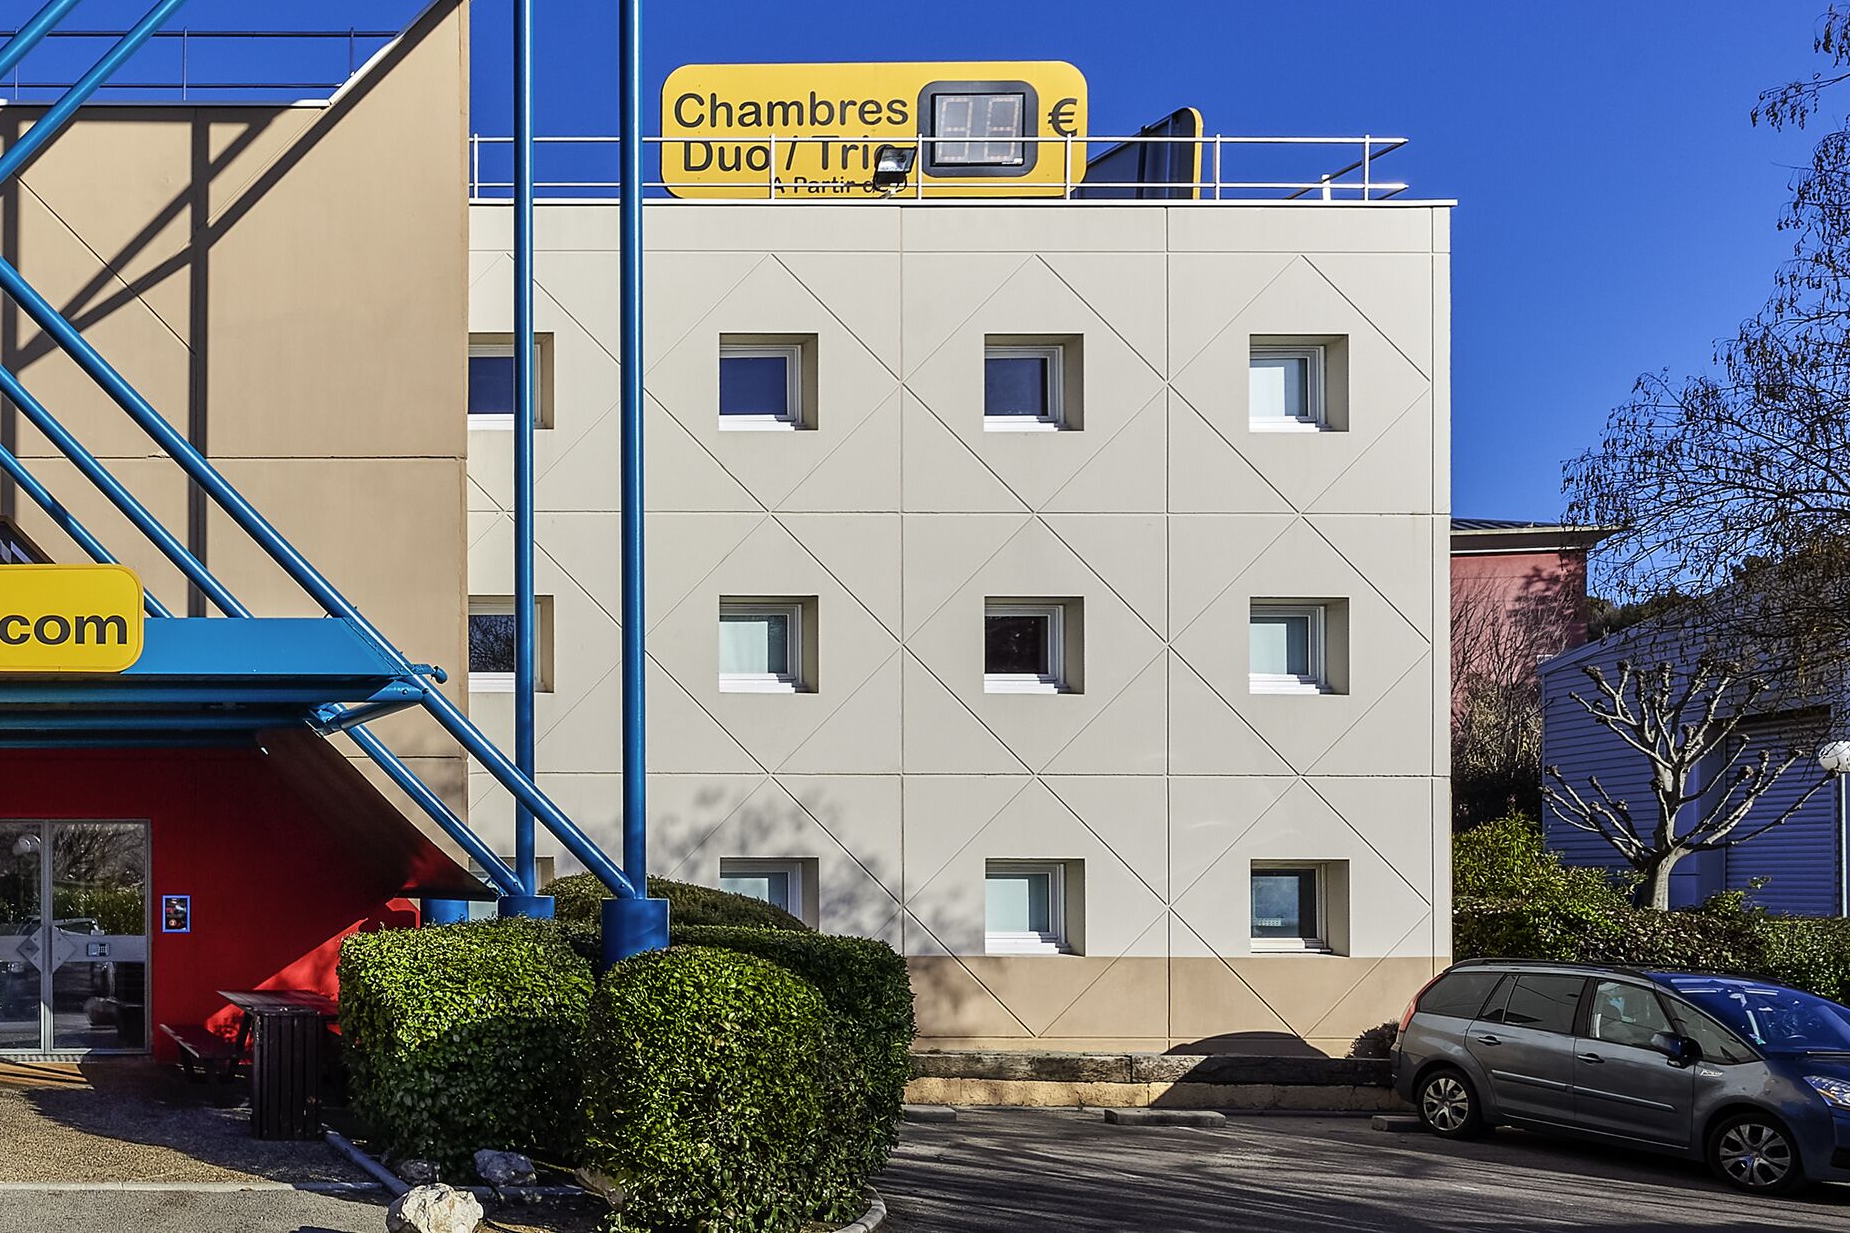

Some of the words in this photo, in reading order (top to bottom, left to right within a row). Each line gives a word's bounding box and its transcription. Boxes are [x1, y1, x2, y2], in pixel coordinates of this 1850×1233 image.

[674, 91, 909, 128] Chambres
[1047, 98, 1078, 137] €
[683, 136, 772, 171] Duo
[793, 176, 856, 194] Partir
